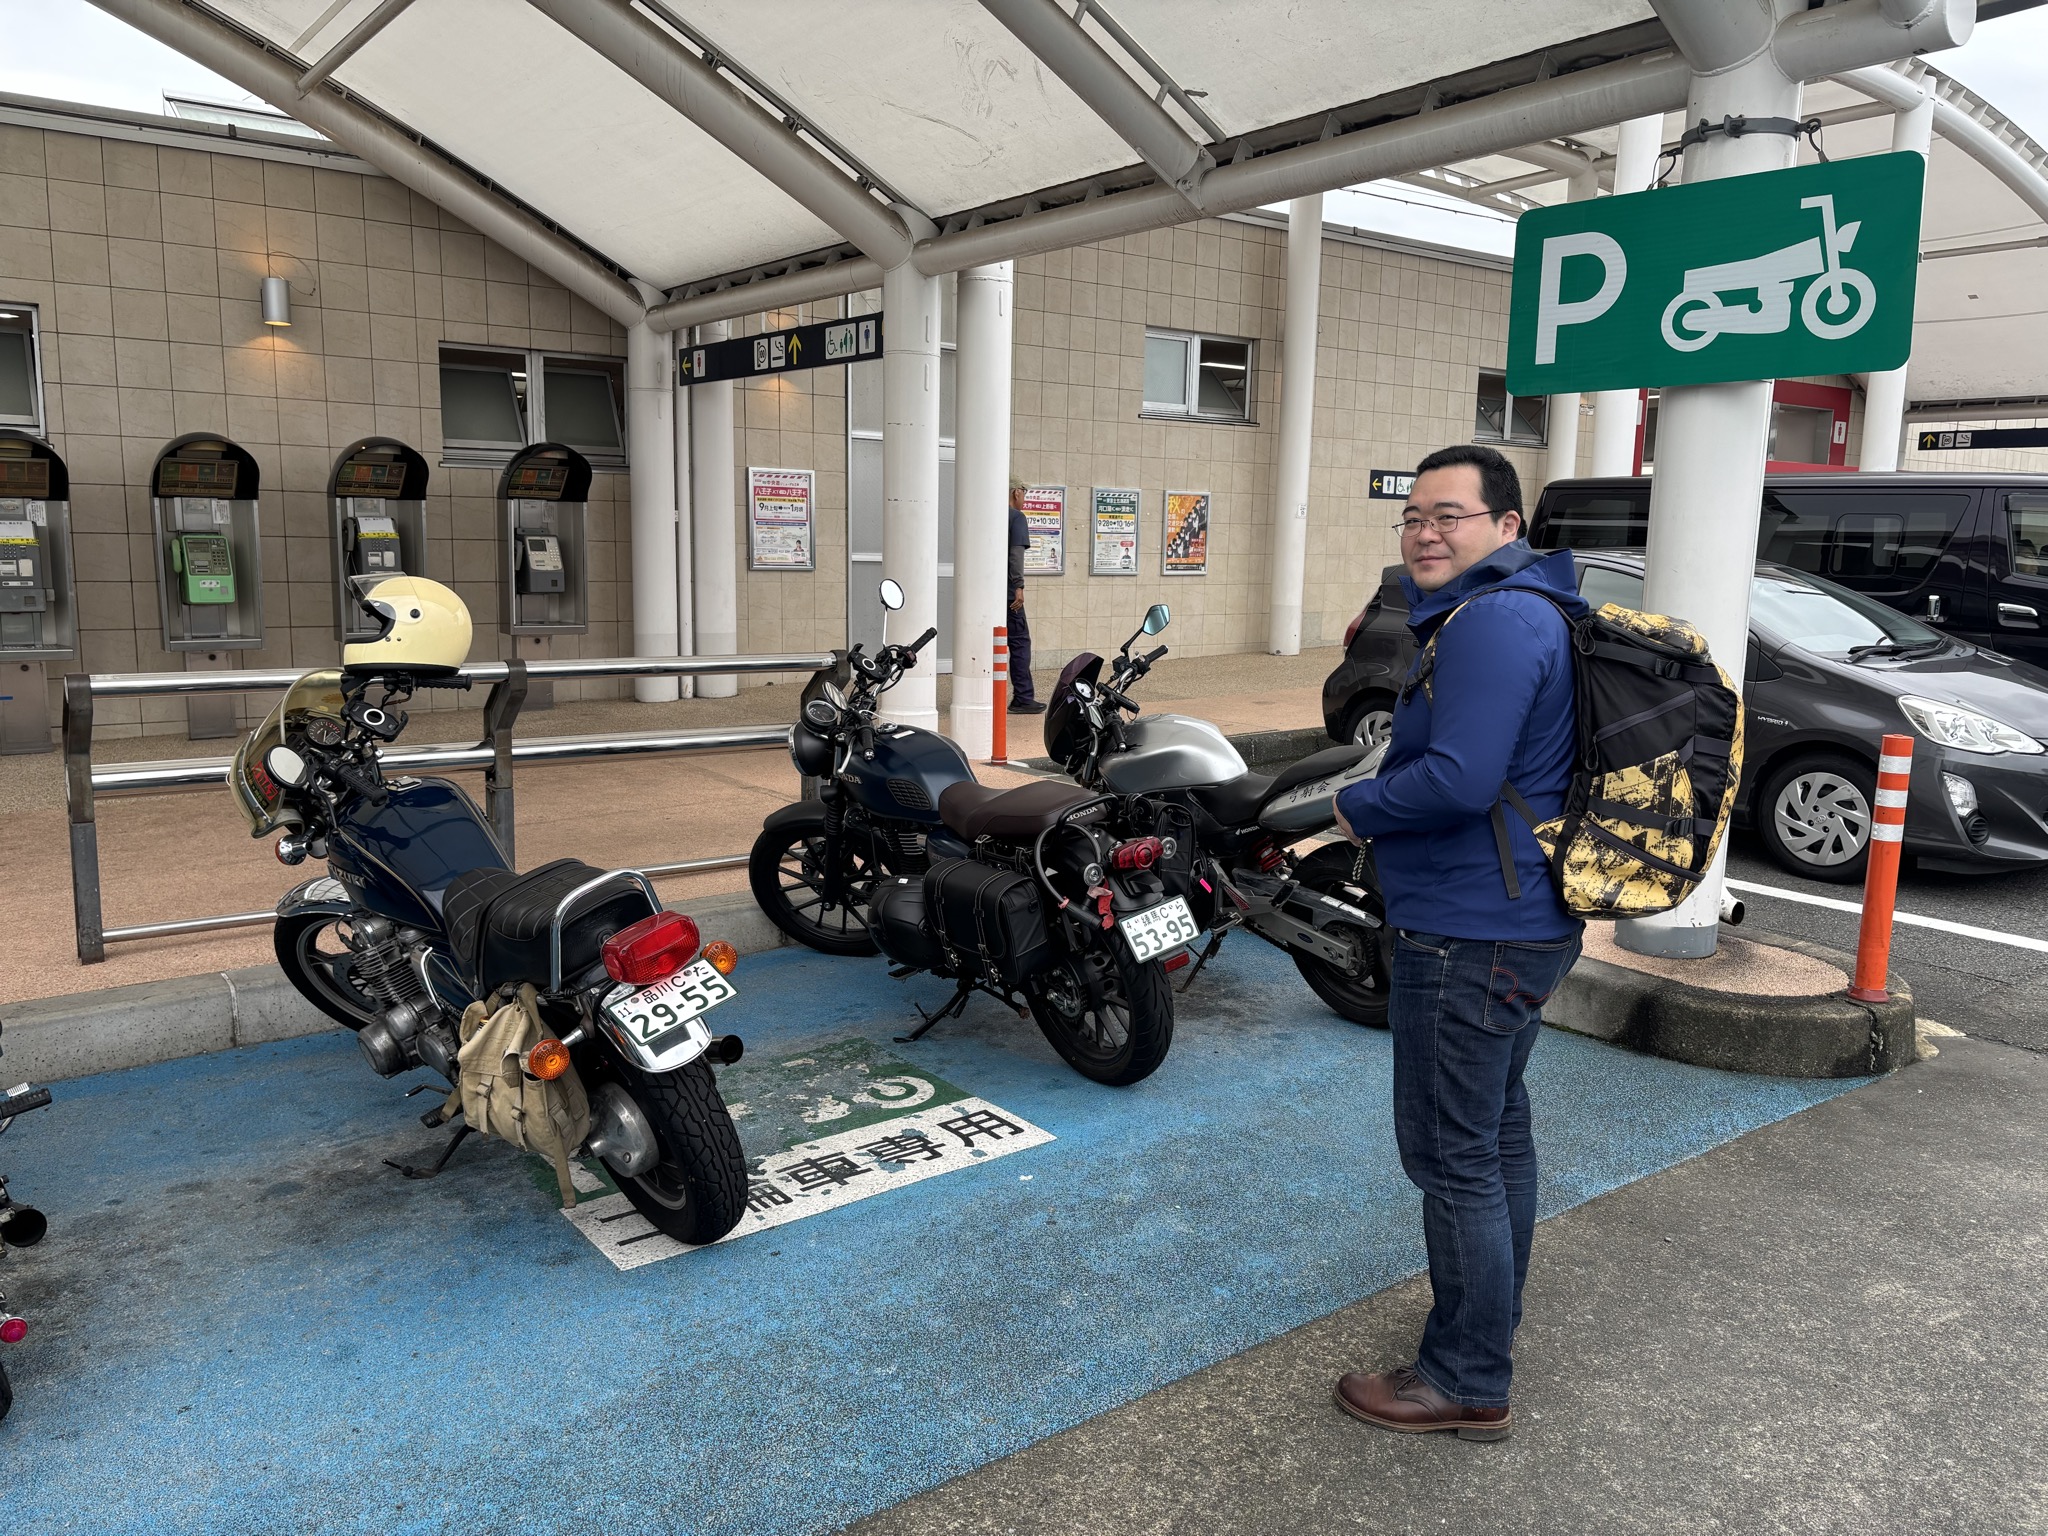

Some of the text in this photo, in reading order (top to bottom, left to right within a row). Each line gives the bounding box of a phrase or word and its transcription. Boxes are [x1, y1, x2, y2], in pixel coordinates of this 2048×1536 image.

[1535, 231, 1627, 365] P
[755, 487, 771, 495] 八王子
[787, 488, 802, 496] 八王子
[1067, 806, 1098, 822] HONDA
[1240, 825, 1260, 835] HONDA
[1131, 913, 1194, 957] 53-95
[629, 975, 729, 1039] 29-55
